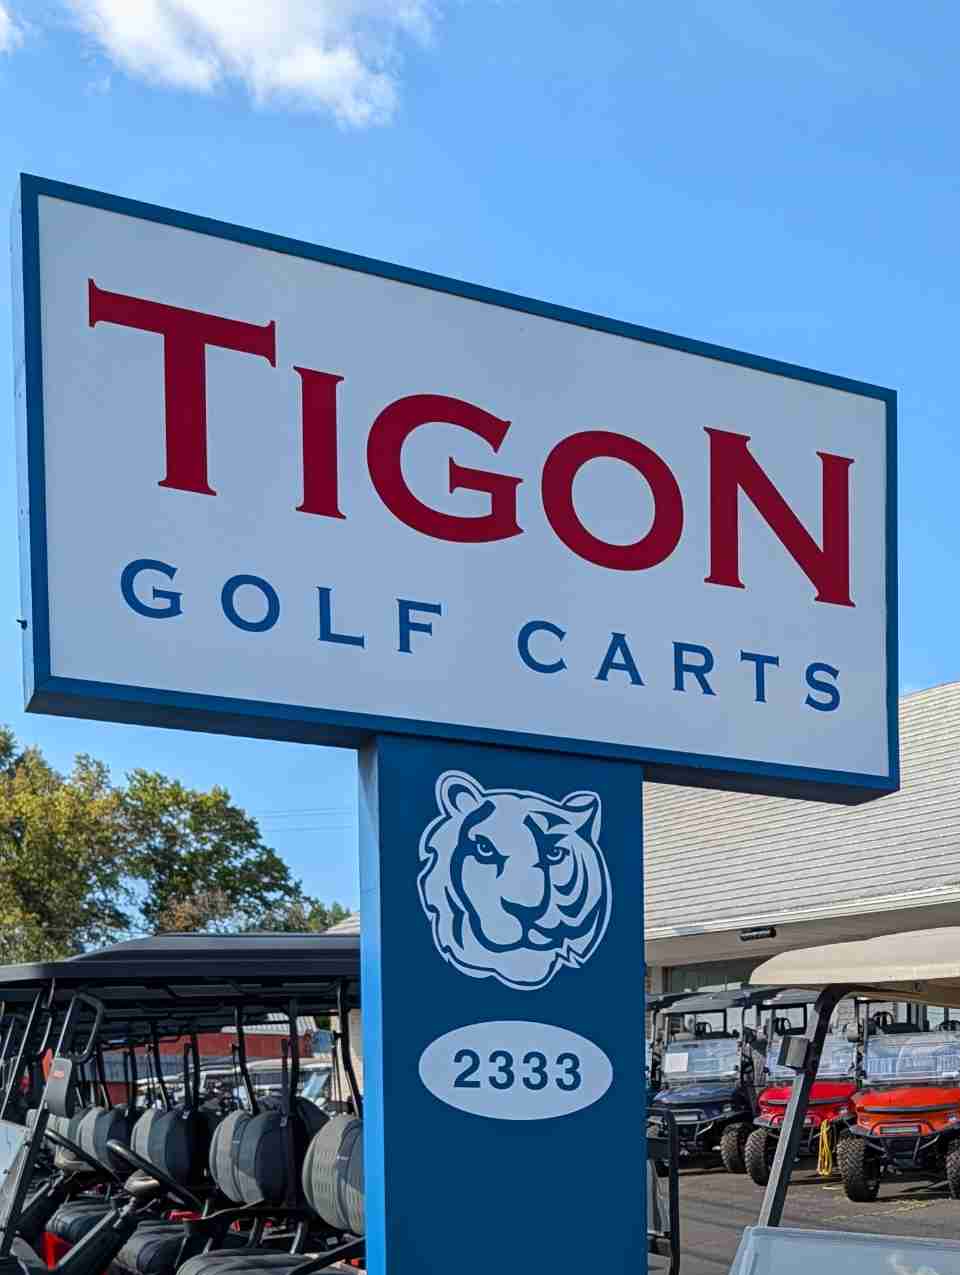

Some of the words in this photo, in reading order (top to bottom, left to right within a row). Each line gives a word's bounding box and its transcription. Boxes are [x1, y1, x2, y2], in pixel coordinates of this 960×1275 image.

[88, 278, 855, 607] TIGON
[119, 558, 443, 656] GOLF
[517, 619, 842, 713] CARTS
[453, 1048, 582, 1092] 2333
